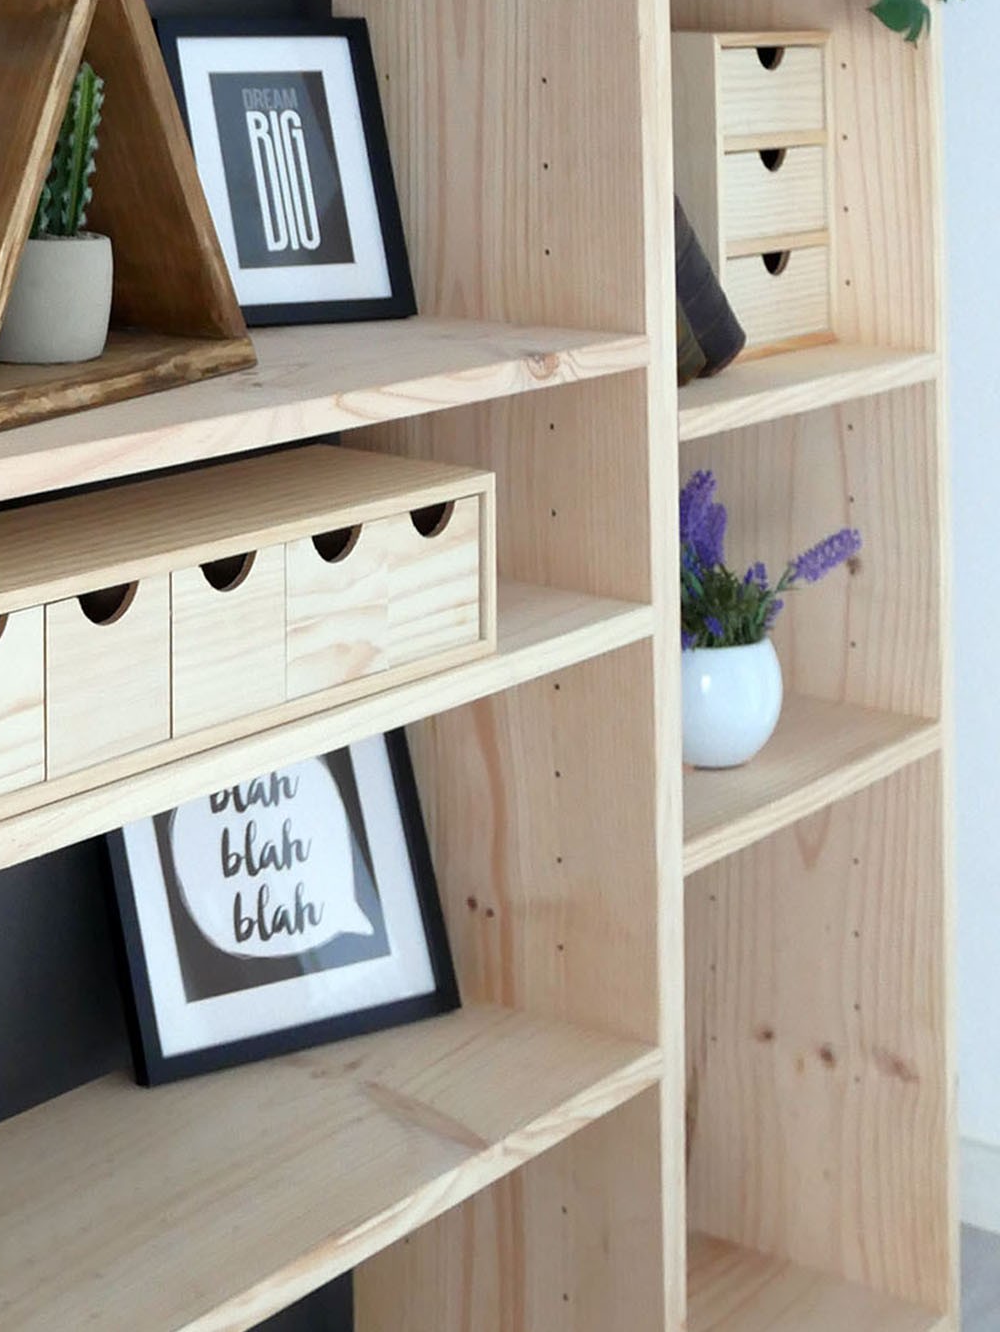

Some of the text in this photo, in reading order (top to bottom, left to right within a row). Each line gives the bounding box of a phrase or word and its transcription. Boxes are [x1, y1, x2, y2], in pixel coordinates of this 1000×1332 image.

[242, 88, 299, 110] DREAM
[246, 109, 322, 252] BIG
[221, 818, 312, 878] blah
[233, 882, 325, 943] blah
